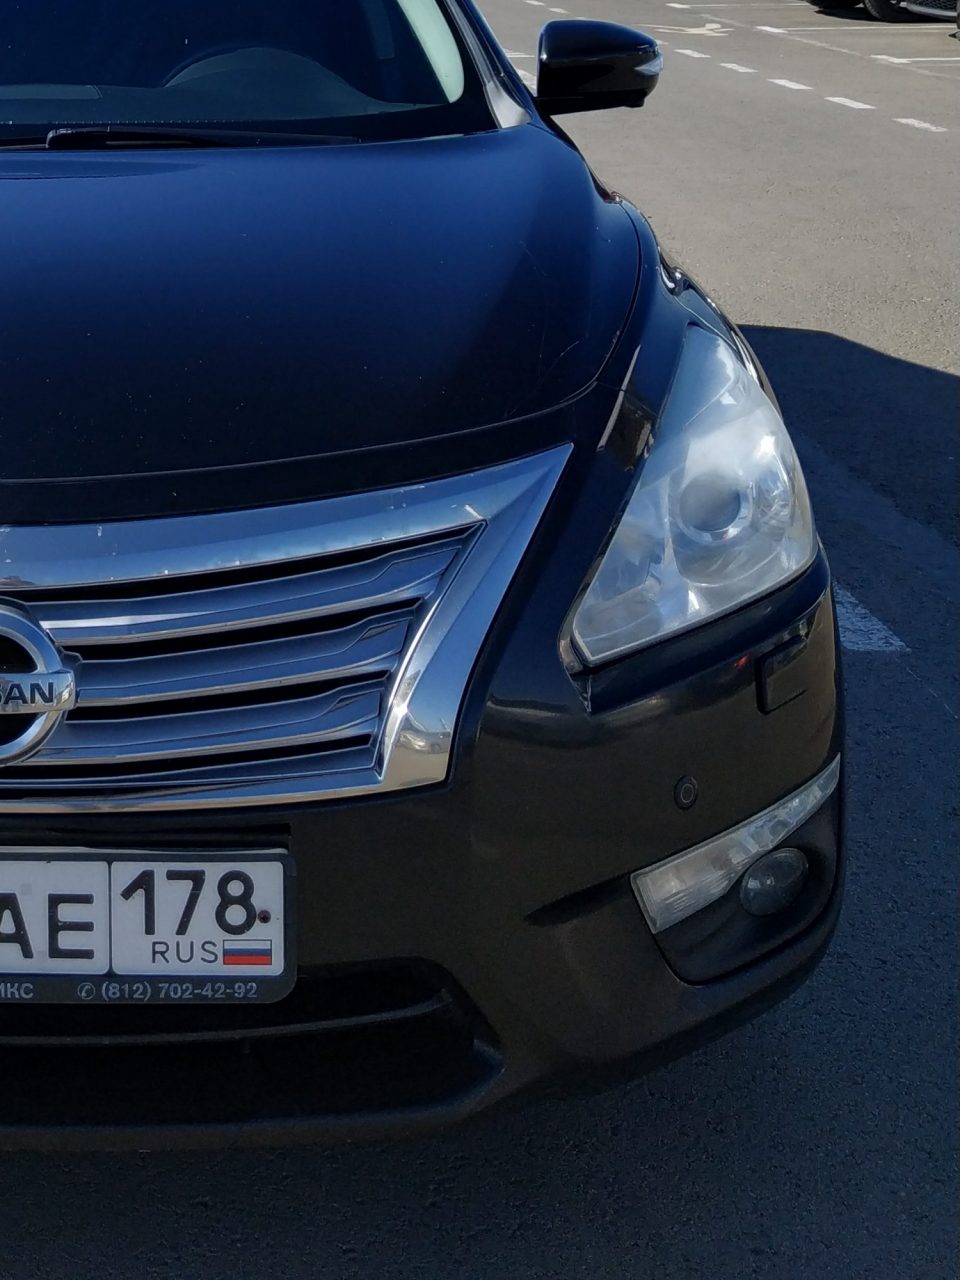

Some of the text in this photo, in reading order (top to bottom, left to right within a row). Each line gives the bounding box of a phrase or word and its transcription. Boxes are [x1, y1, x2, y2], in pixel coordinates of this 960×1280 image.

[120, 869, 258, 936] 178
[152, 941, 218, 964] RUS
[101, 982, 258, 1001] (812) 702-42-92
